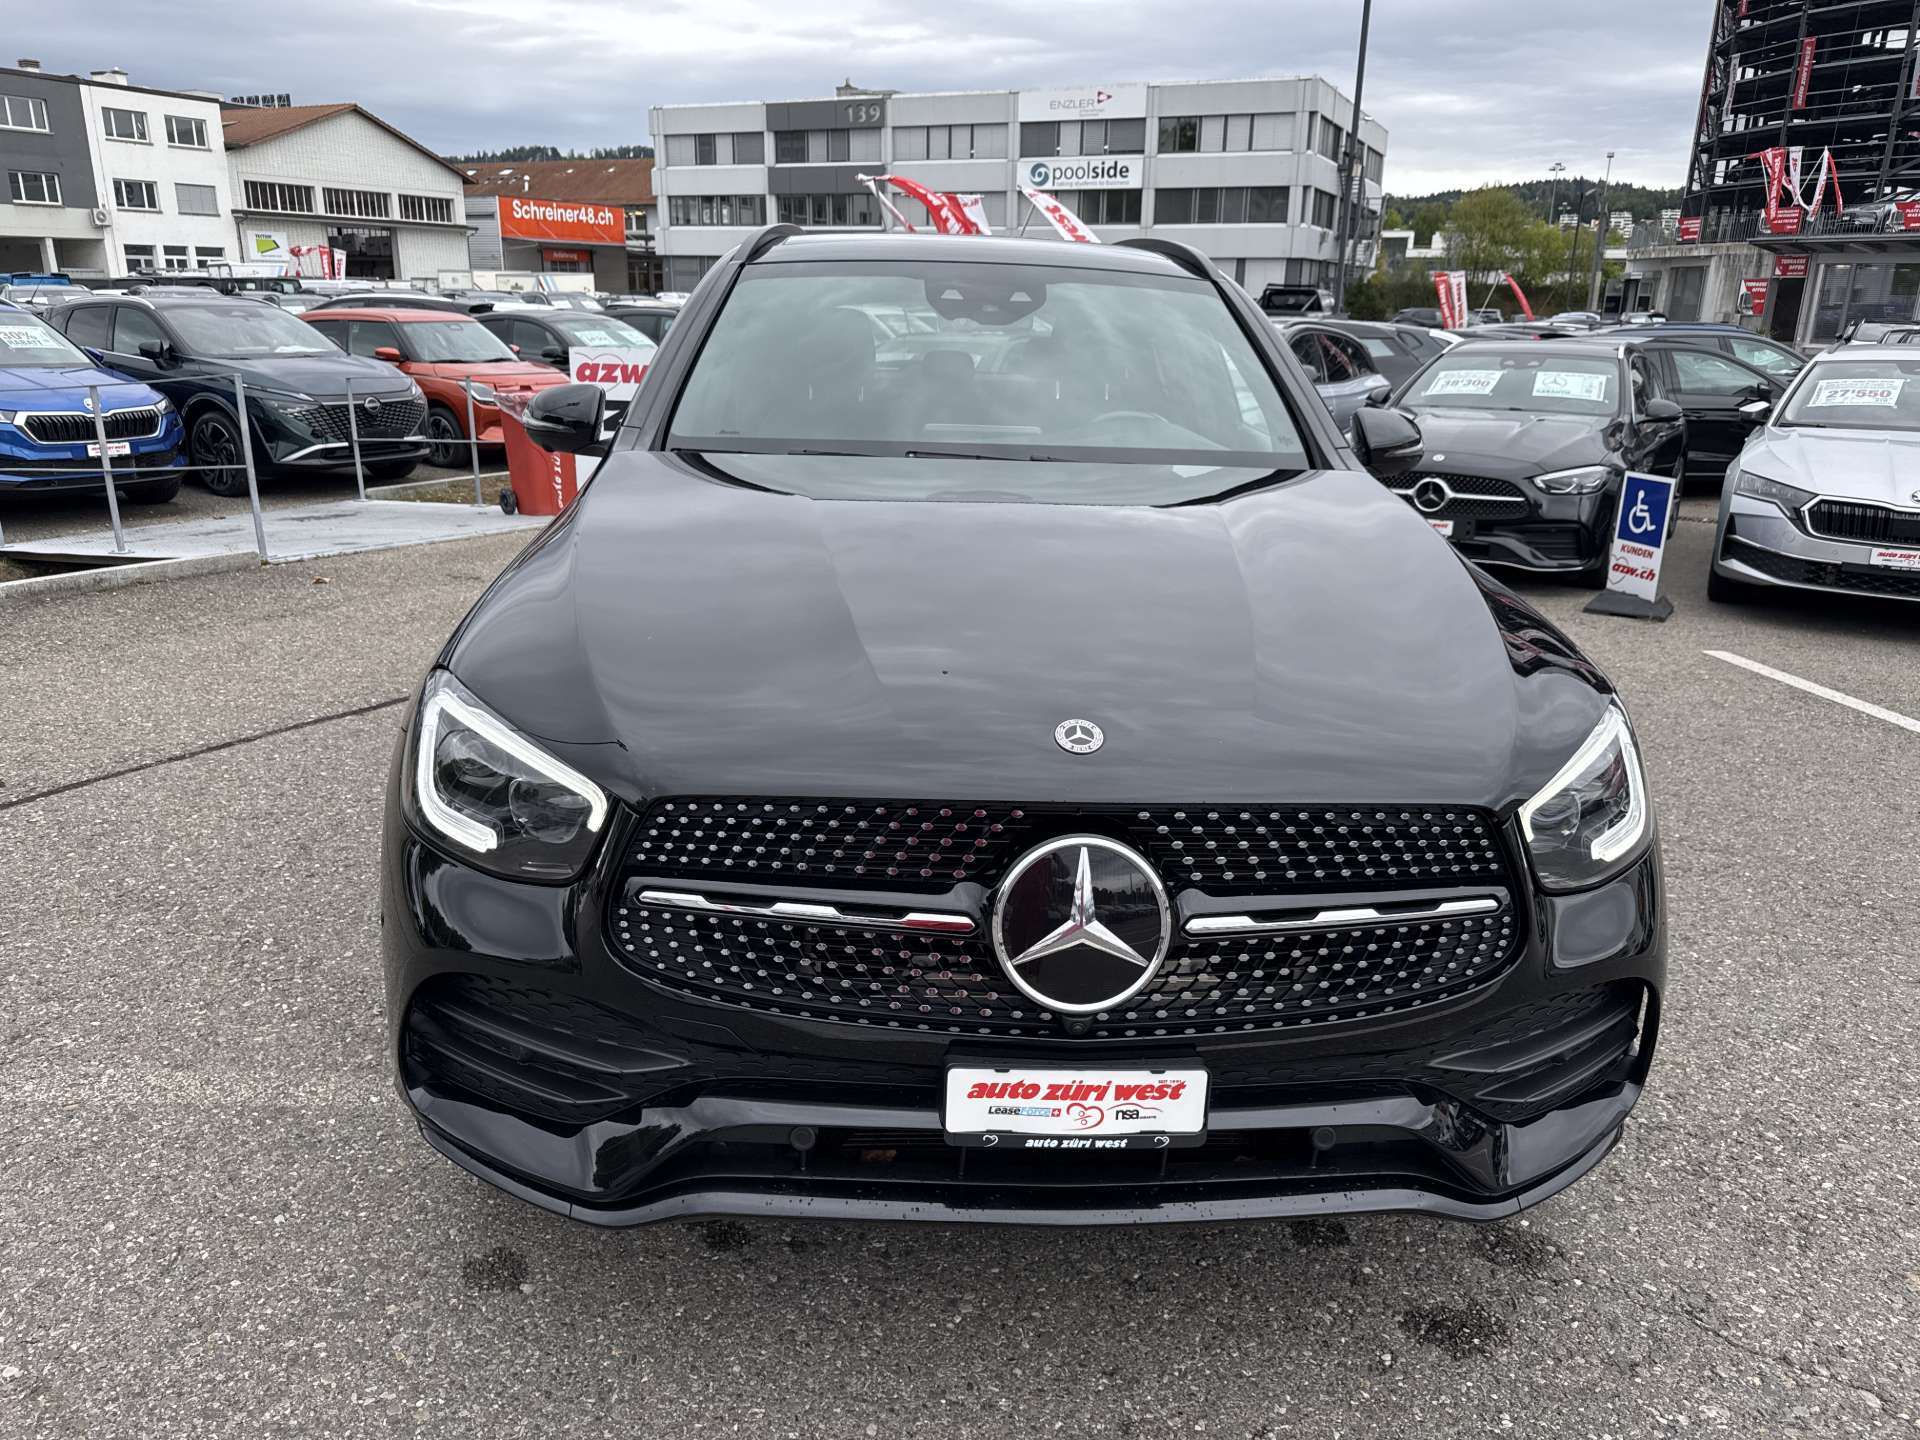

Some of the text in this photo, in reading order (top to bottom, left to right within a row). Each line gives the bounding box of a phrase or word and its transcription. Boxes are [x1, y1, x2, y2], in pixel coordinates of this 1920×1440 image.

[845, 103, 881, 122] 139
[1049, 98, 1095, 110] ENZLER
[1053, 161, 1130, 186] poolside
[512, 199, 614, 226] Schreiner48.ch
[1826, 389, 1892, 398] 27'550
[1620, 544, 1654, 559] KUNDEN
[1612, 563, 1656, 582] azw.ch
[967, 1079, 1187, 1101] auto züri west
[1115, 1108, 1139, 1120] nsa
[1025, 1137, 1128, 1148] auto züri west
